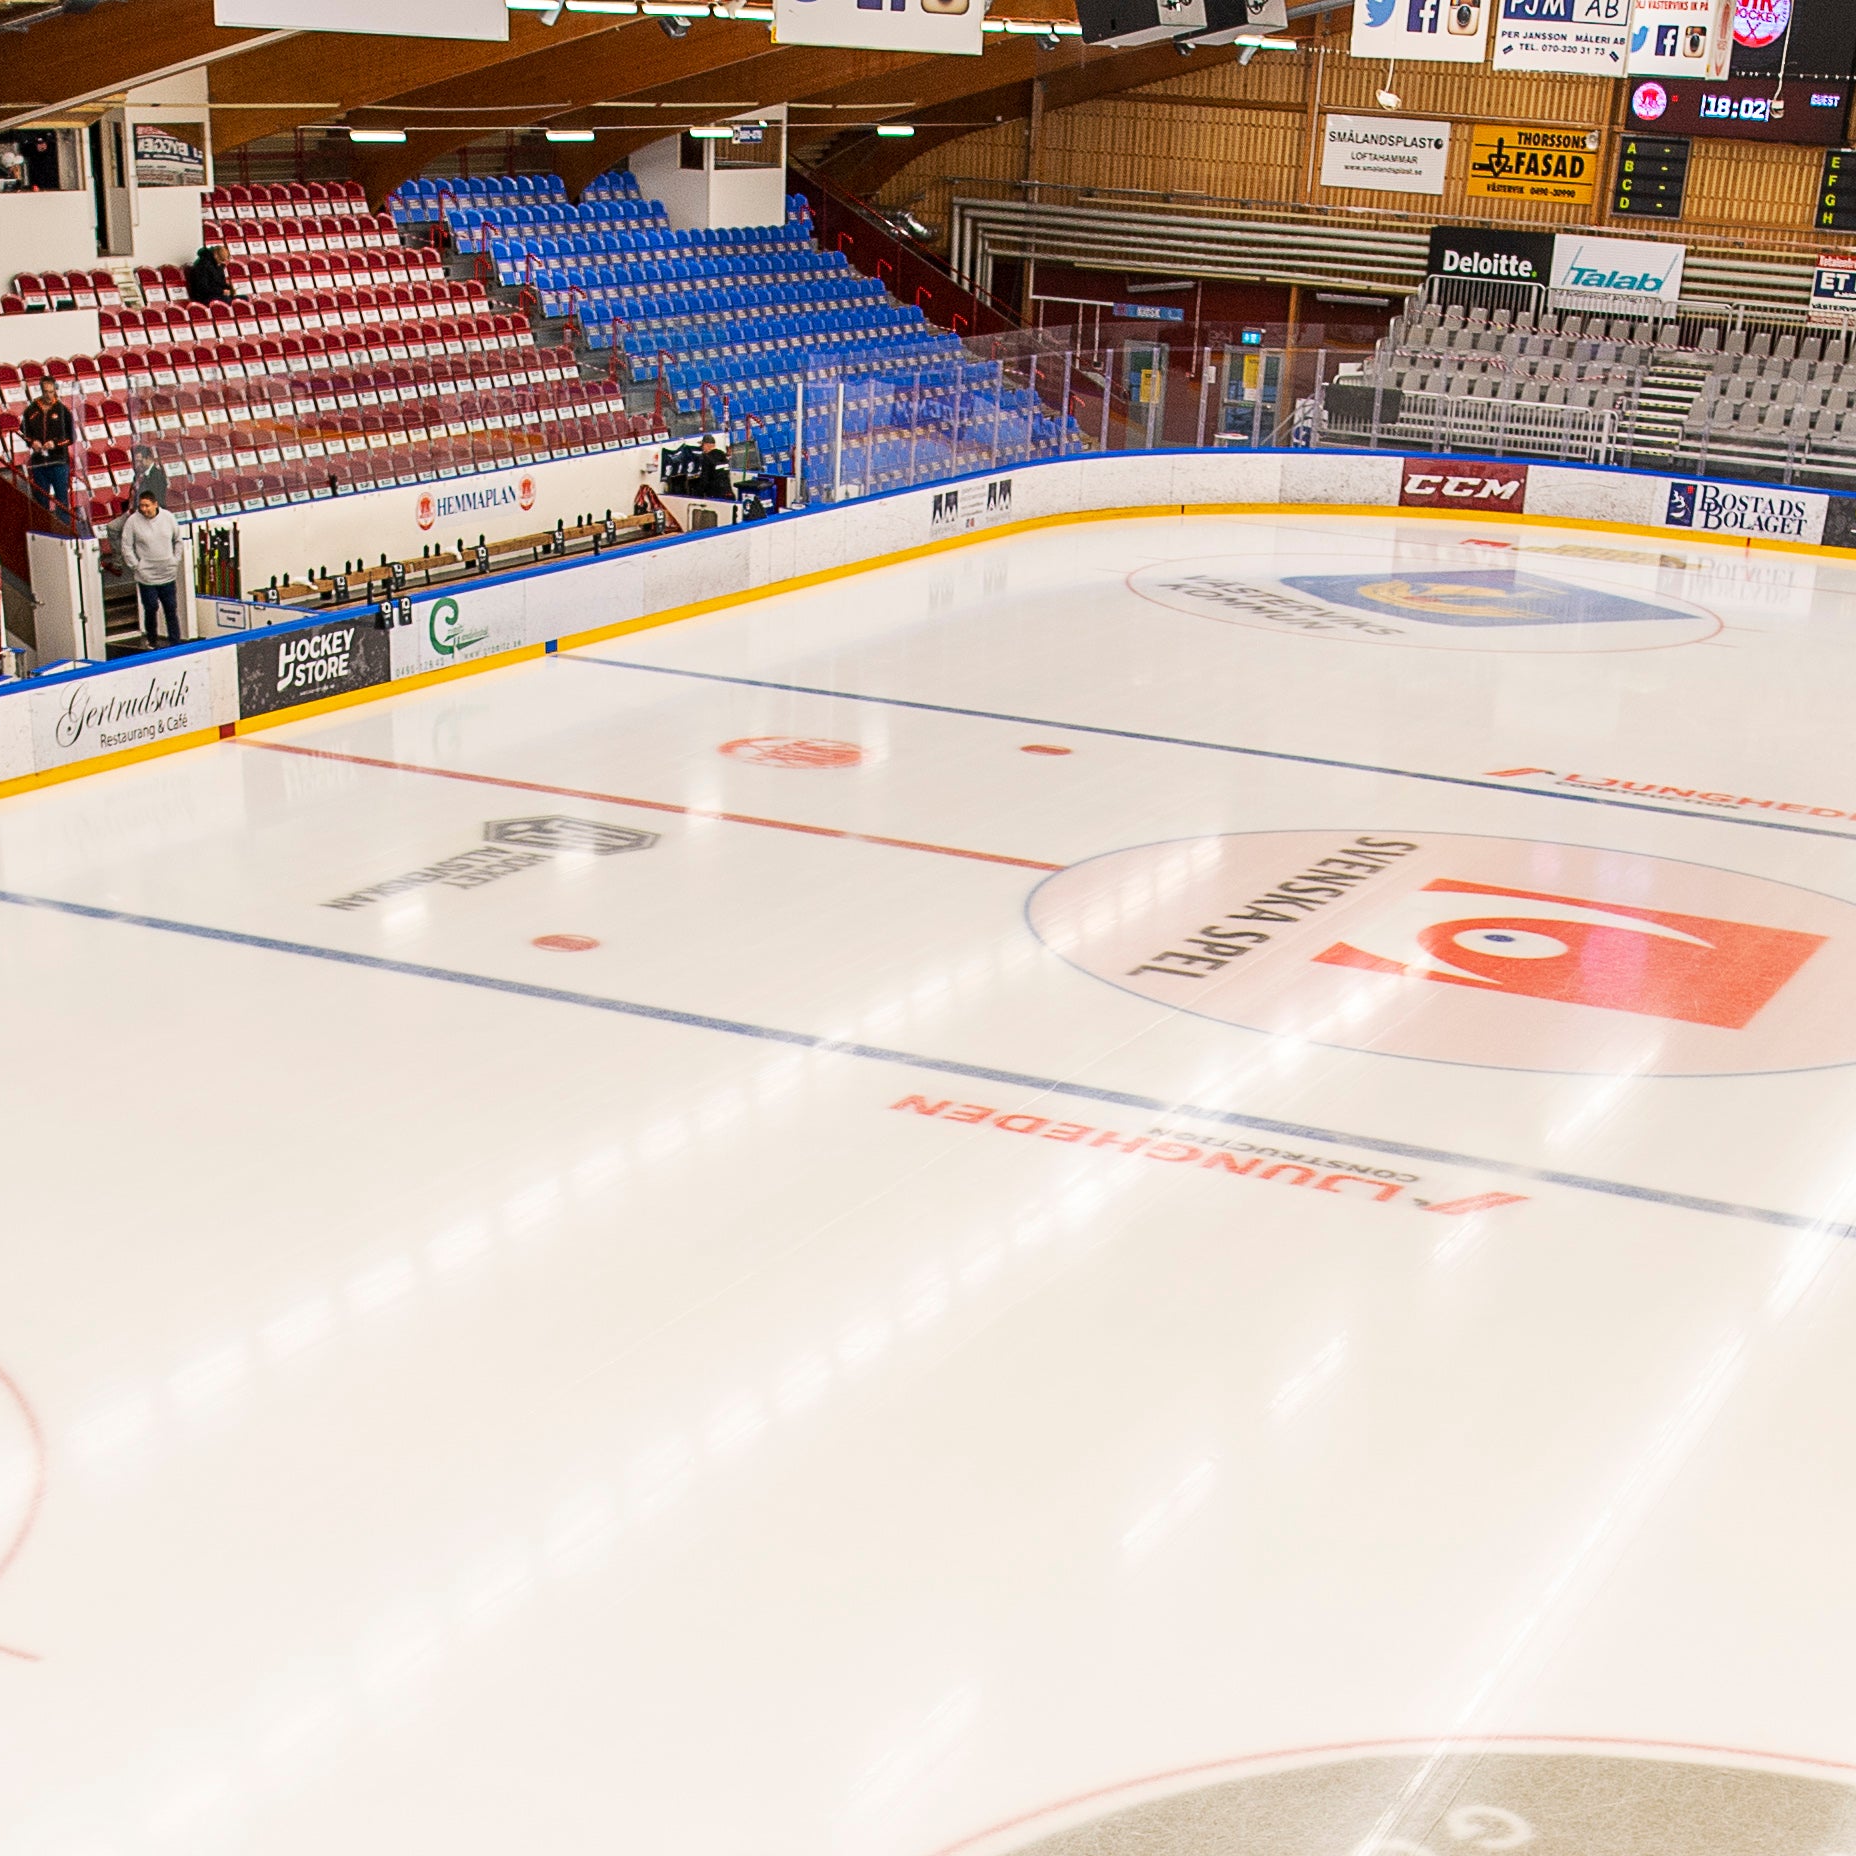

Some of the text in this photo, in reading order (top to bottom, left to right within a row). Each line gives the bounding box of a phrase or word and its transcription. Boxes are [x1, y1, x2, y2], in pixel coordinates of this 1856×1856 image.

[1501, 30, 1626, 45] PER JANSSON MÅLERI AB
[1519, 43, 1538, 52] TEL.
[1541, 44, 1577, 54] 070-320
[1594, 47, 1606, 56] 73
[1704, 96, 1766, 120] 18:02
[1809, 93, 1841, 108] GUEST
[1517, 131, 1588, 149] THORSSONS
[1626, 143, 1637, 155] A
[1350, 151, 1419, 165] LOFTAHAMMAR
[1514, 151, 1585, 178] FASAD
[1624, 161, 1635, 173] B
[1831, 157, 1841, 169] E
[1622, 179, 1632, 191] C
[1828, 175, 1838, 188] F
[1619, 198, 1630, 210] D
[1825, 194, 1836, 207] G
[1822, 212, 1834, 225] H
[1568, 264, 1665, 293] Talab
[1820, 271, 1847, 291] ET
[437, 485, 517, 517] HEMMAPLAN
[1403, 473, 1522, 501] CCM
[1697, 483, 1806, 519] BOSTADS
[1702, 501, 1808, 537] BOLAGET
[1156, 582, 1337, 631] KOMMUN
[1181, 573, 1408, 638] VÄSTERVIKS
[278, 626, 355, 668] HOCKEY
[293, 656, 350, 690] STORE
[56, 670, 191, 749] Gertrudsvik
[99, 714, 189, 750] Restaurang & Café
[1553, 779, 1742, 811] CONSTRUCTION
[319, 845, 513, 912] ALLSVENSKAN
[440, 850, 555, 890] HOCKEY
[1225, 836, 1421, 924] SVENSKA
[1124, 925, 1272, 979] SPEL
[887, 1093, 1407, 1202] LJUNGHEDEN
